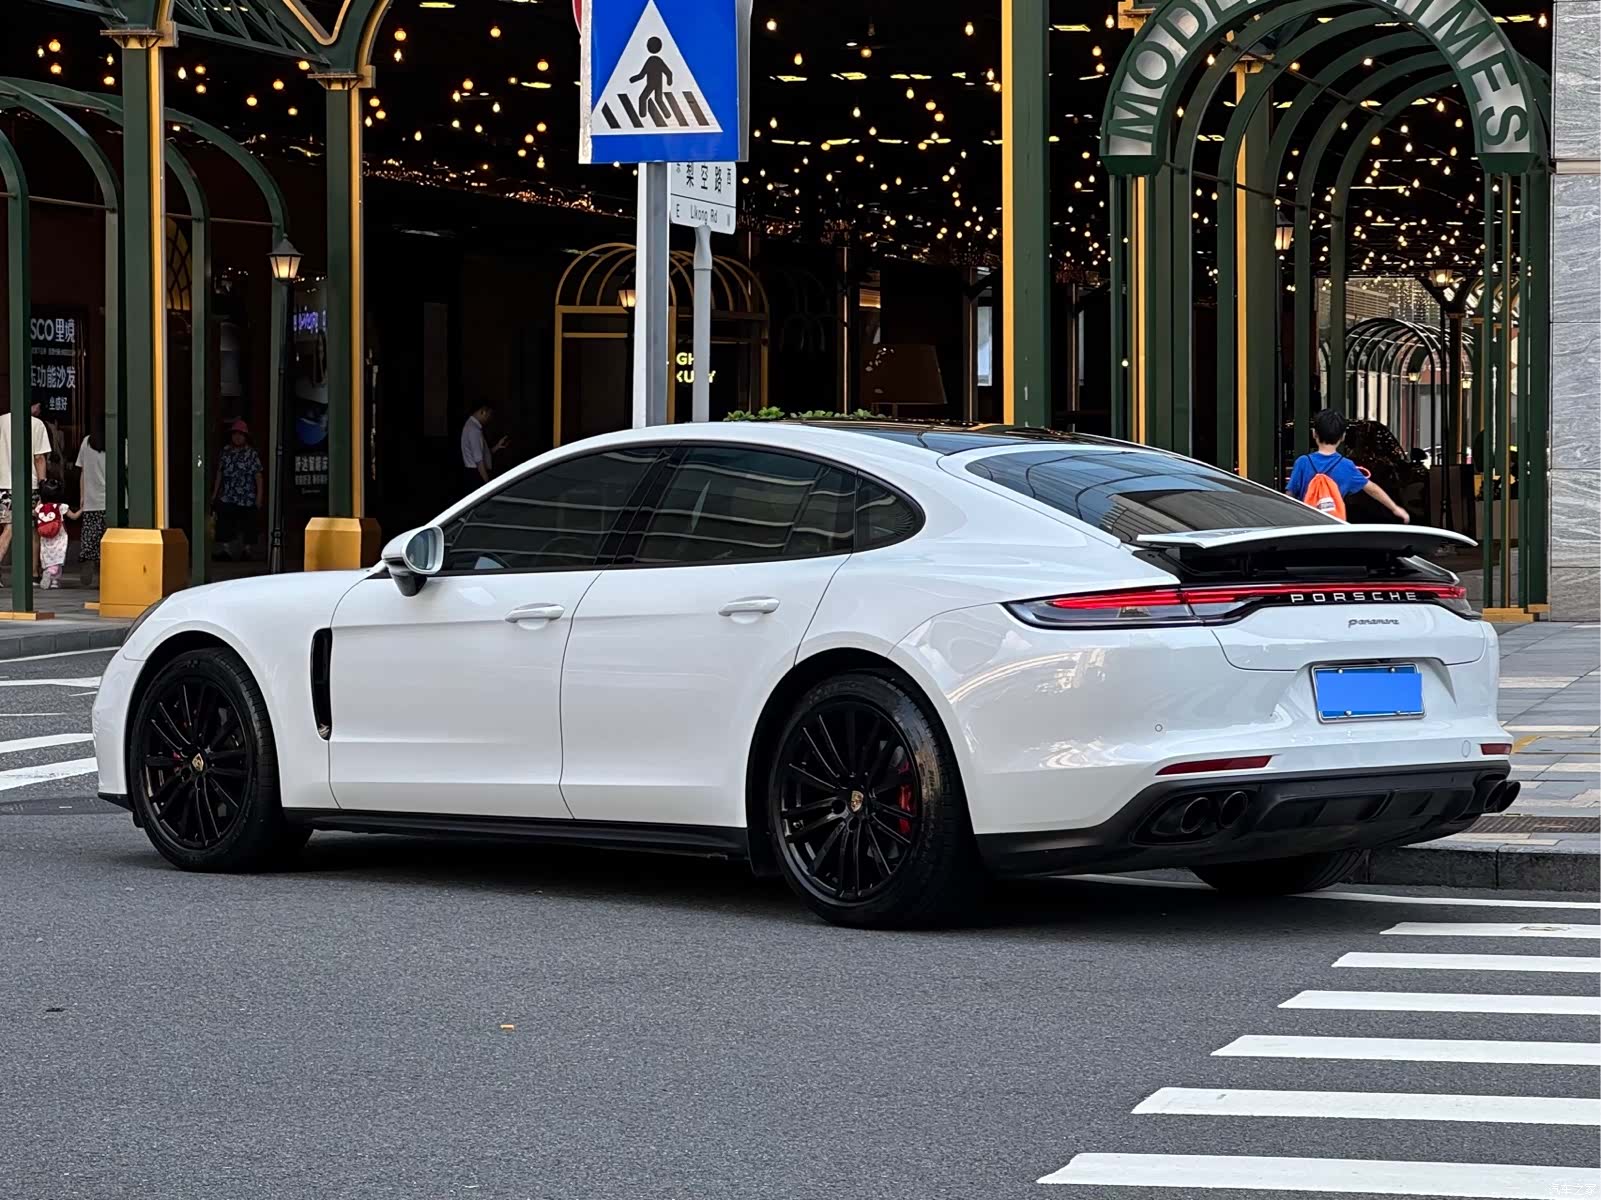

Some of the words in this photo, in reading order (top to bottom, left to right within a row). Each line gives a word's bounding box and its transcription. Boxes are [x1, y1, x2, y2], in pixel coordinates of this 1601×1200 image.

[1386, 0, 1529, 146] IMES
[710, 208, 718, 224] Rd
[1290, 591, 1417, 603] PORSCHE
